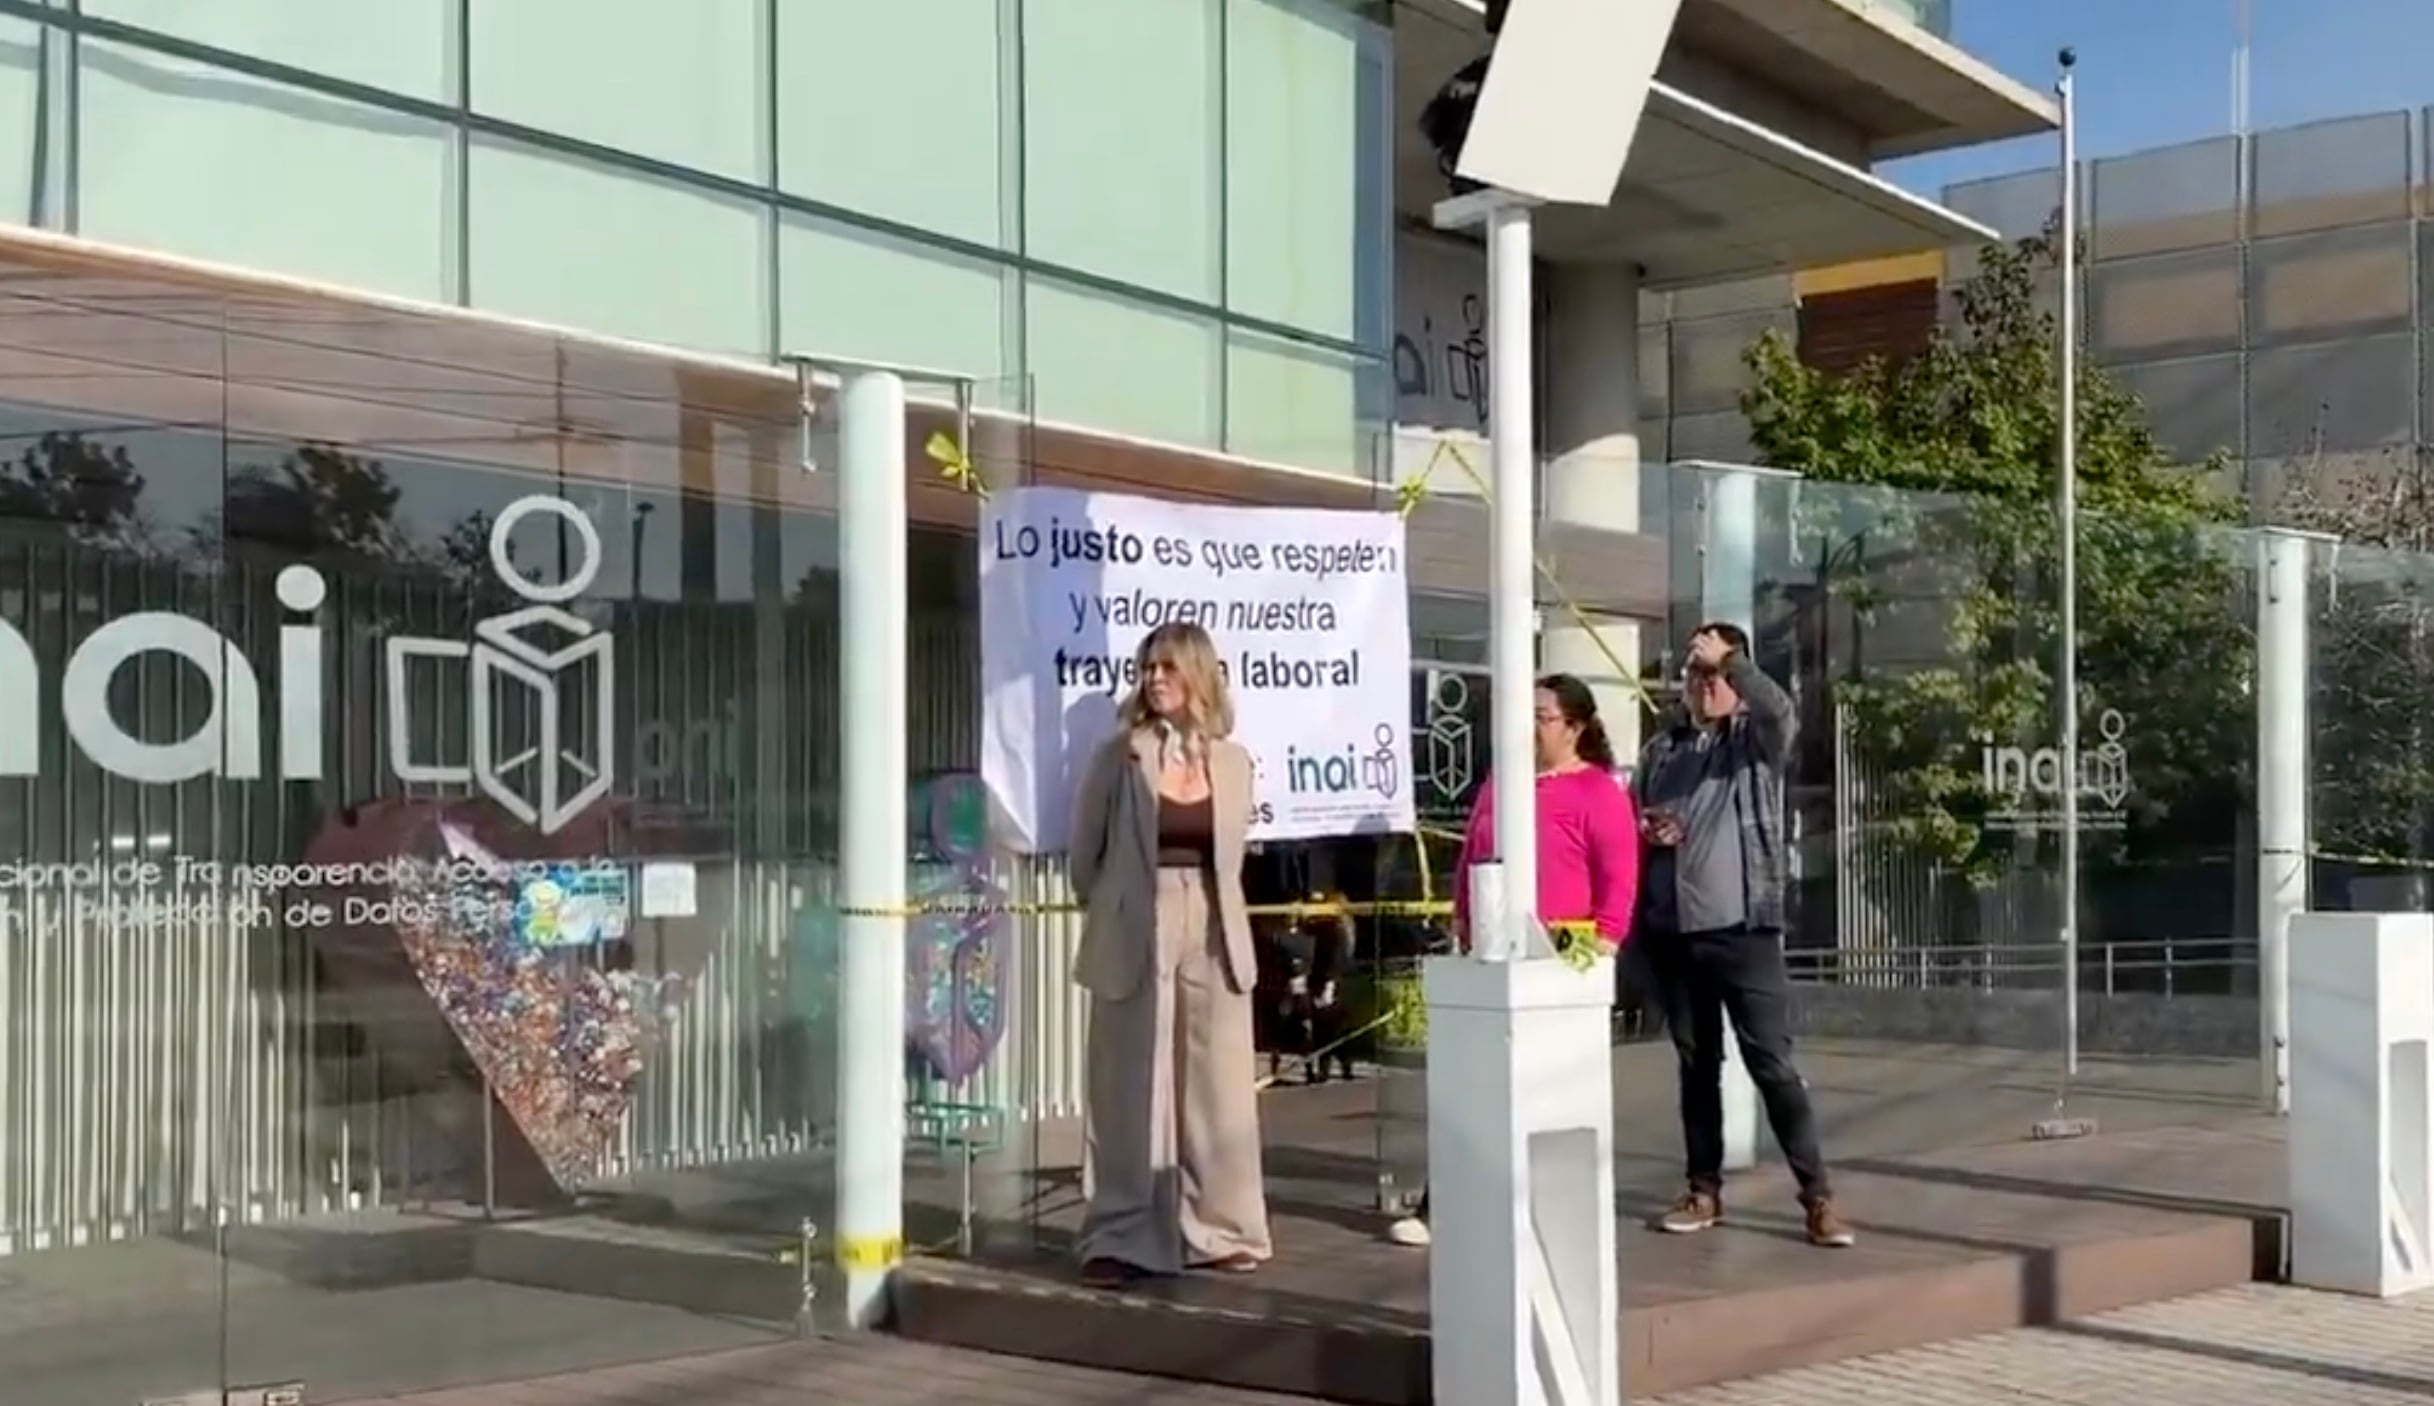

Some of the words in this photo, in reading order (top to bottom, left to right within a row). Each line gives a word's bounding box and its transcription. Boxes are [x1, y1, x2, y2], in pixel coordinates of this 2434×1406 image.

[995, 519, 1040, 560] Lo
[1051, 516, 1143, 568] justo
[1153, 536, 1193, 567] es
[1201, 540, 1263, 578] que
[1272, 538, 1397, 582] respeten
[1069, 591, 1087, 635] y
[1094, 588, 1217, 629] valoren
[1227, 596, 1336, 631] nuestra
[1241, 650, 1359, 688] laboral
[1288, 744, 1357, 793] inai
[113, 856, 162, 886] de
[285, 900, 332, 927] de
[343, 897, 439, 925] Datos
